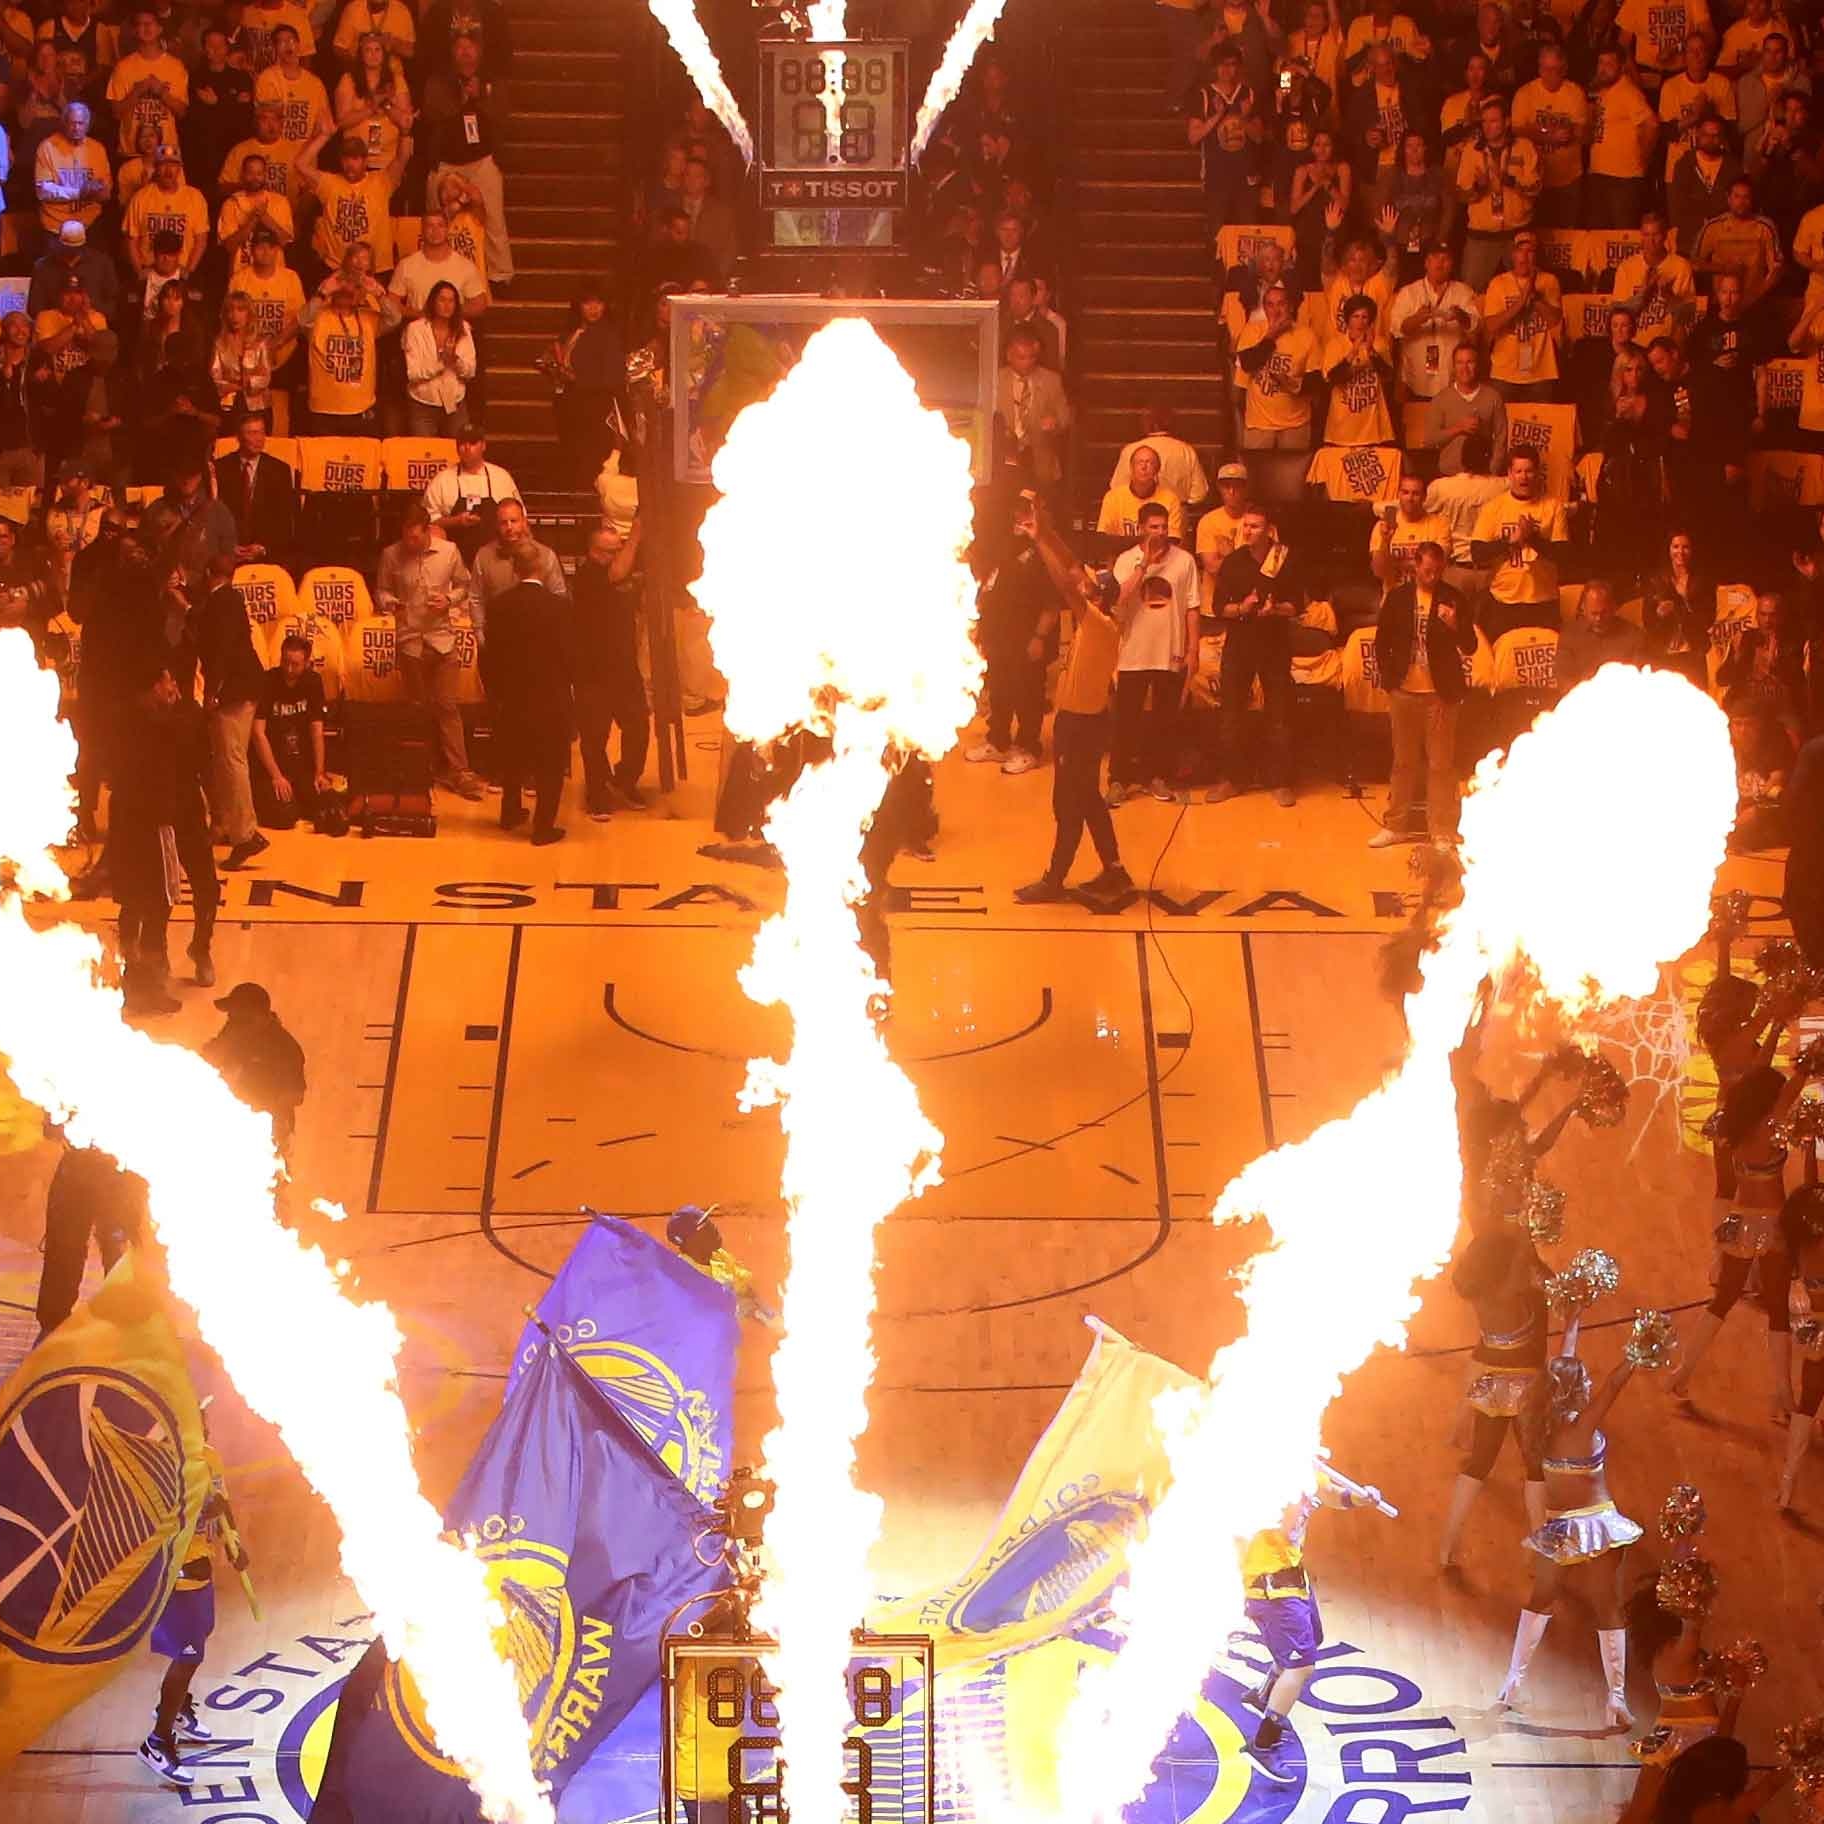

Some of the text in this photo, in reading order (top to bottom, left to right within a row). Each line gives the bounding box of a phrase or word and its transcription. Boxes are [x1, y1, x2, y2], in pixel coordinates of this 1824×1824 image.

[804, 181, 898, 197] TISSOT
[147, 215, 186, 233] DUBS
[256, 302, 285, 319] UBS
[325, 337, 364, 354] DUBS
[1510, 422, 1554, 445] DUBS
[1342, 450, 1380, 475] DUBS
[325, 463, 364, 483] DUBS
[1347, 463, 1388, 488] STAND
[313, 584, 354, 601] DUBS
[314, 600, 354, 618] STAND
[362, 631, 395, 648] DUB
[362, 648, 395, 665] STAN
[1514, 648, 1556, 668] DUBS
